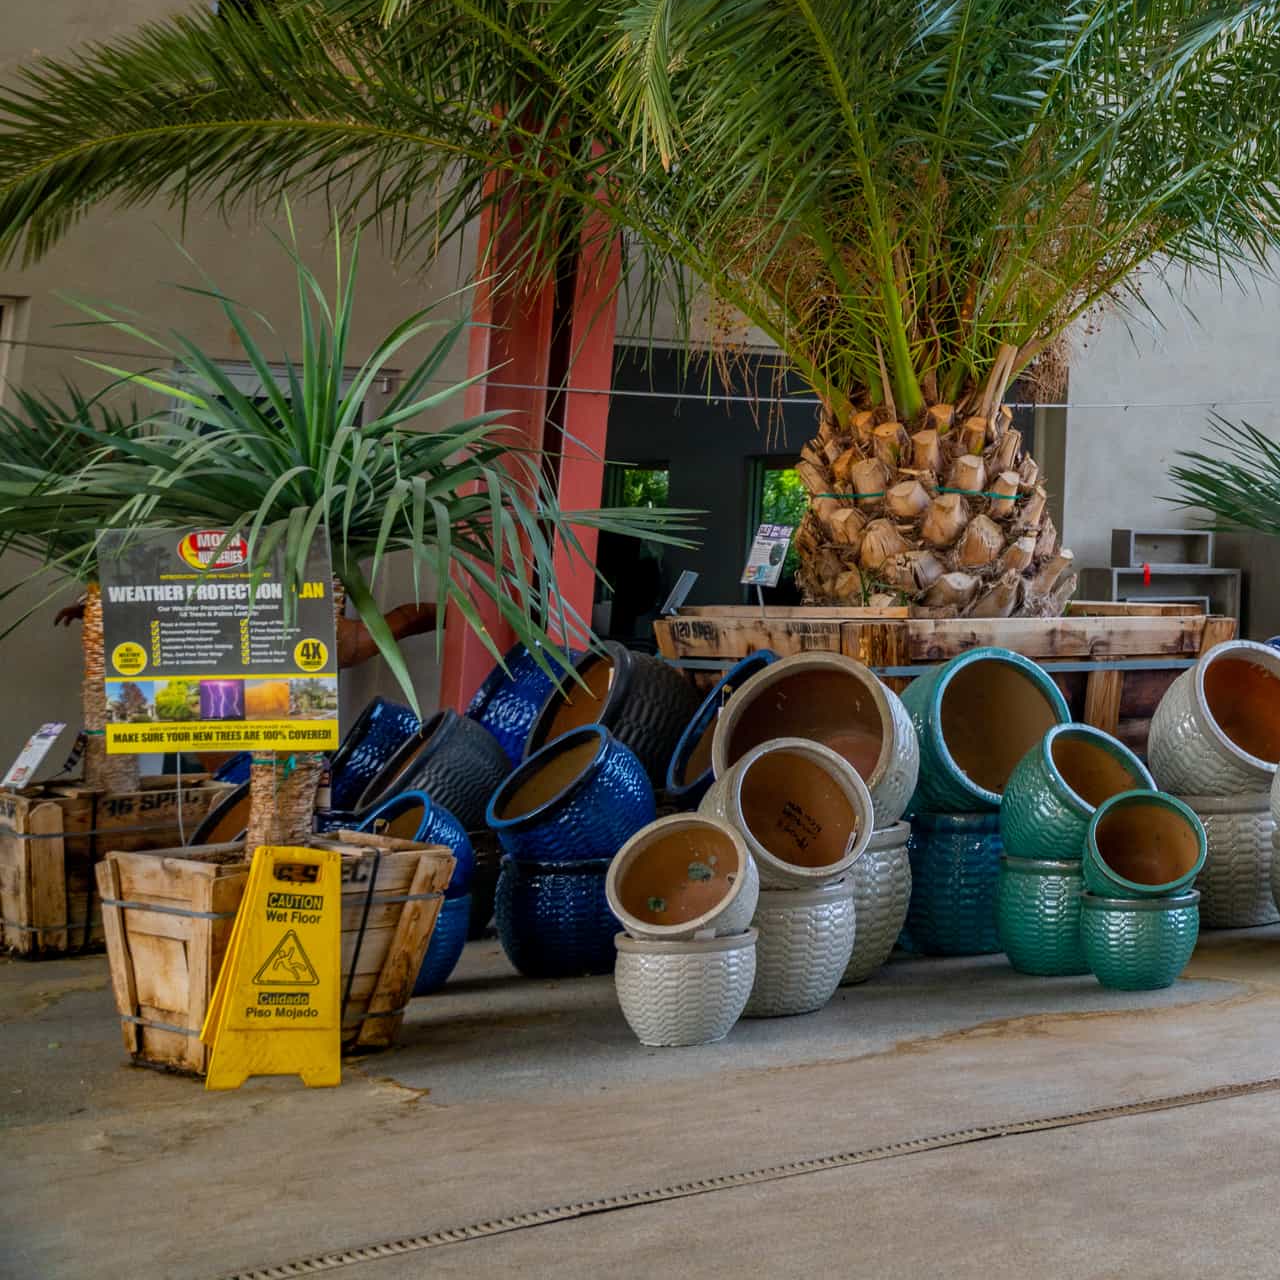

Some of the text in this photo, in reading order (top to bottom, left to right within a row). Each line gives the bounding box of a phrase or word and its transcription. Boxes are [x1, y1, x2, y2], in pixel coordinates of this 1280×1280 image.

[108, 585, 183, 603] WEATHER
[300, 642, 321, 658] 4X
[113, 729, 332, 743] MAKE SURE YOUR NEW TREES ARE 100% COVERED!
[268, 894, 322, 910] CAUTION
[266, 910, 322, 924] Wet Floor
[259, 993, 308, 1005] Cuidado
[245, 1007, 319, 1020] Piso Mojado
